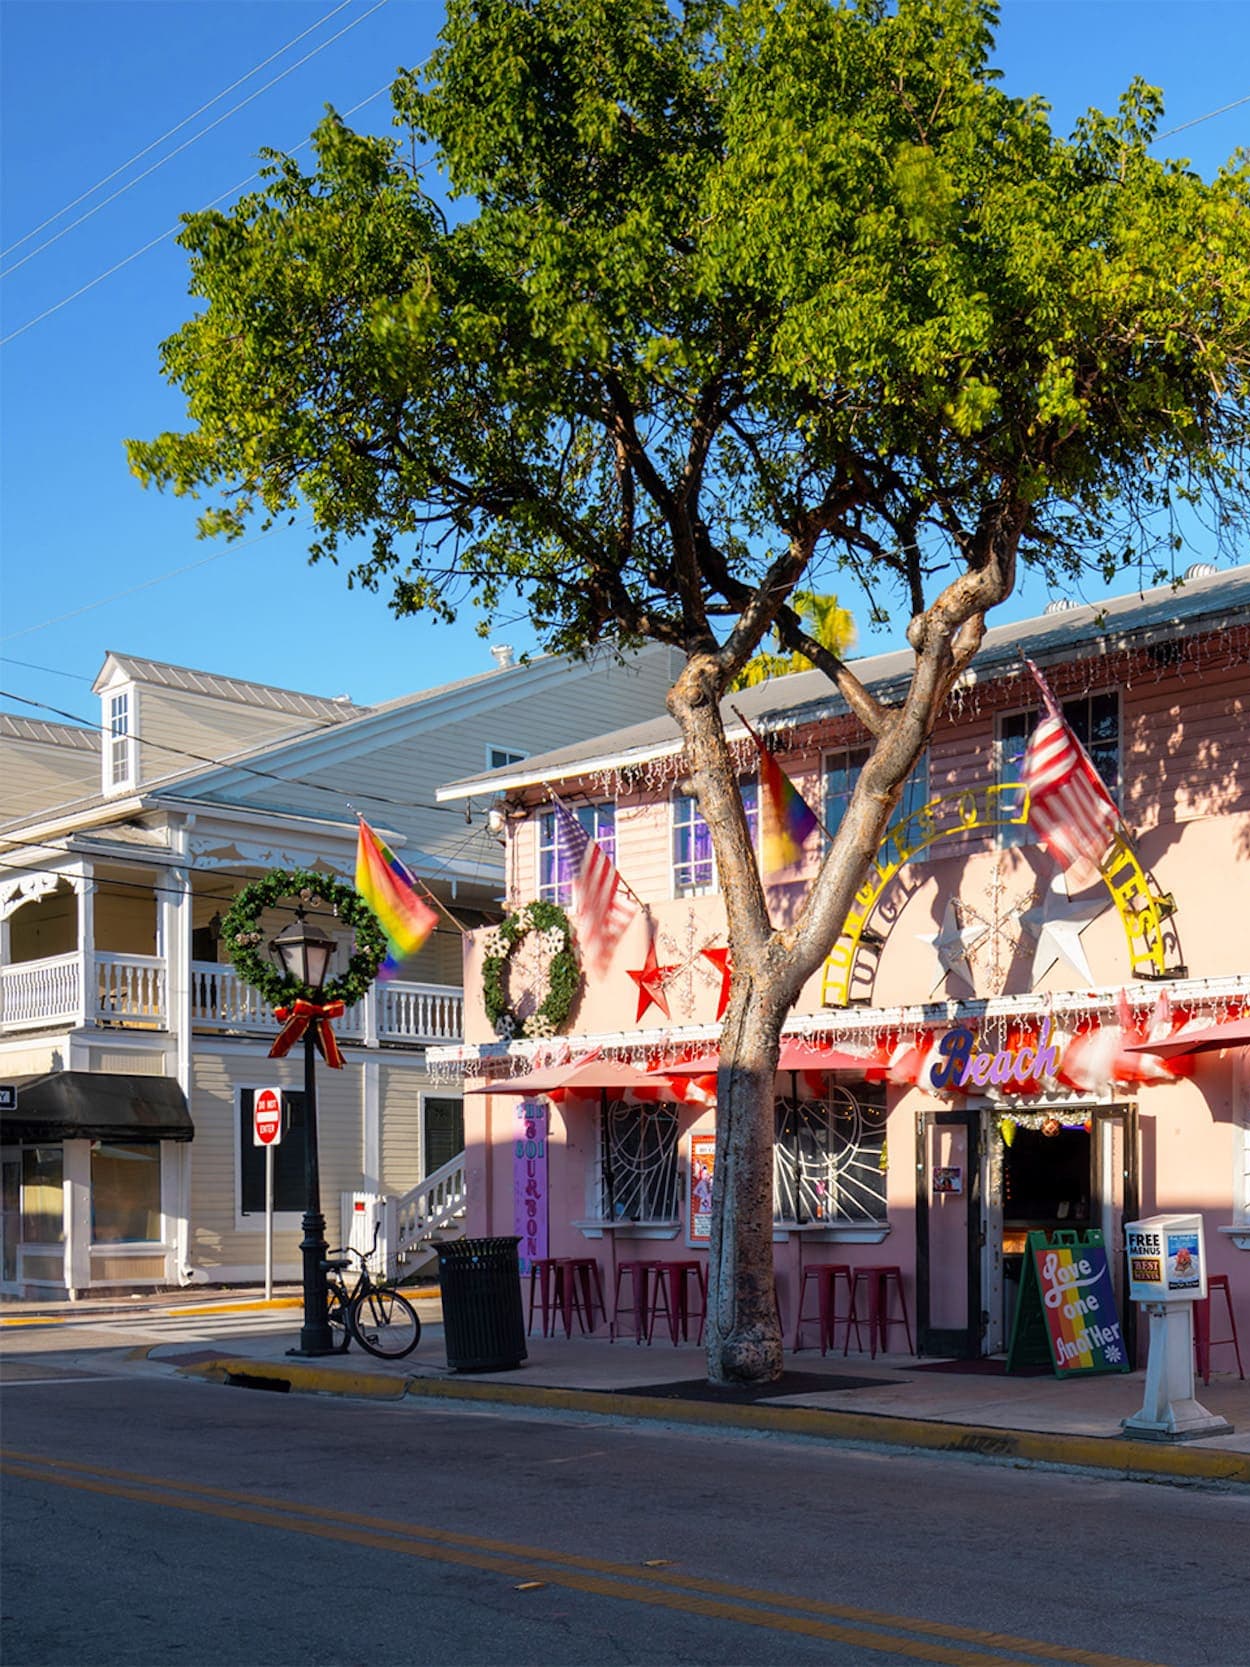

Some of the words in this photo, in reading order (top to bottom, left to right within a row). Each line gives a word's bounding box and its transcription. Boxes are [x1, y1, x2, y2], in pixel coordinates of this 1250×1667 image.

[515, 1140, 544, 1159] 801
[1129, 1233, 1160, 1246] FREE
[1043, 1253, 1107, 1308] Love
[1063, 1295, 1100, 1319] one
